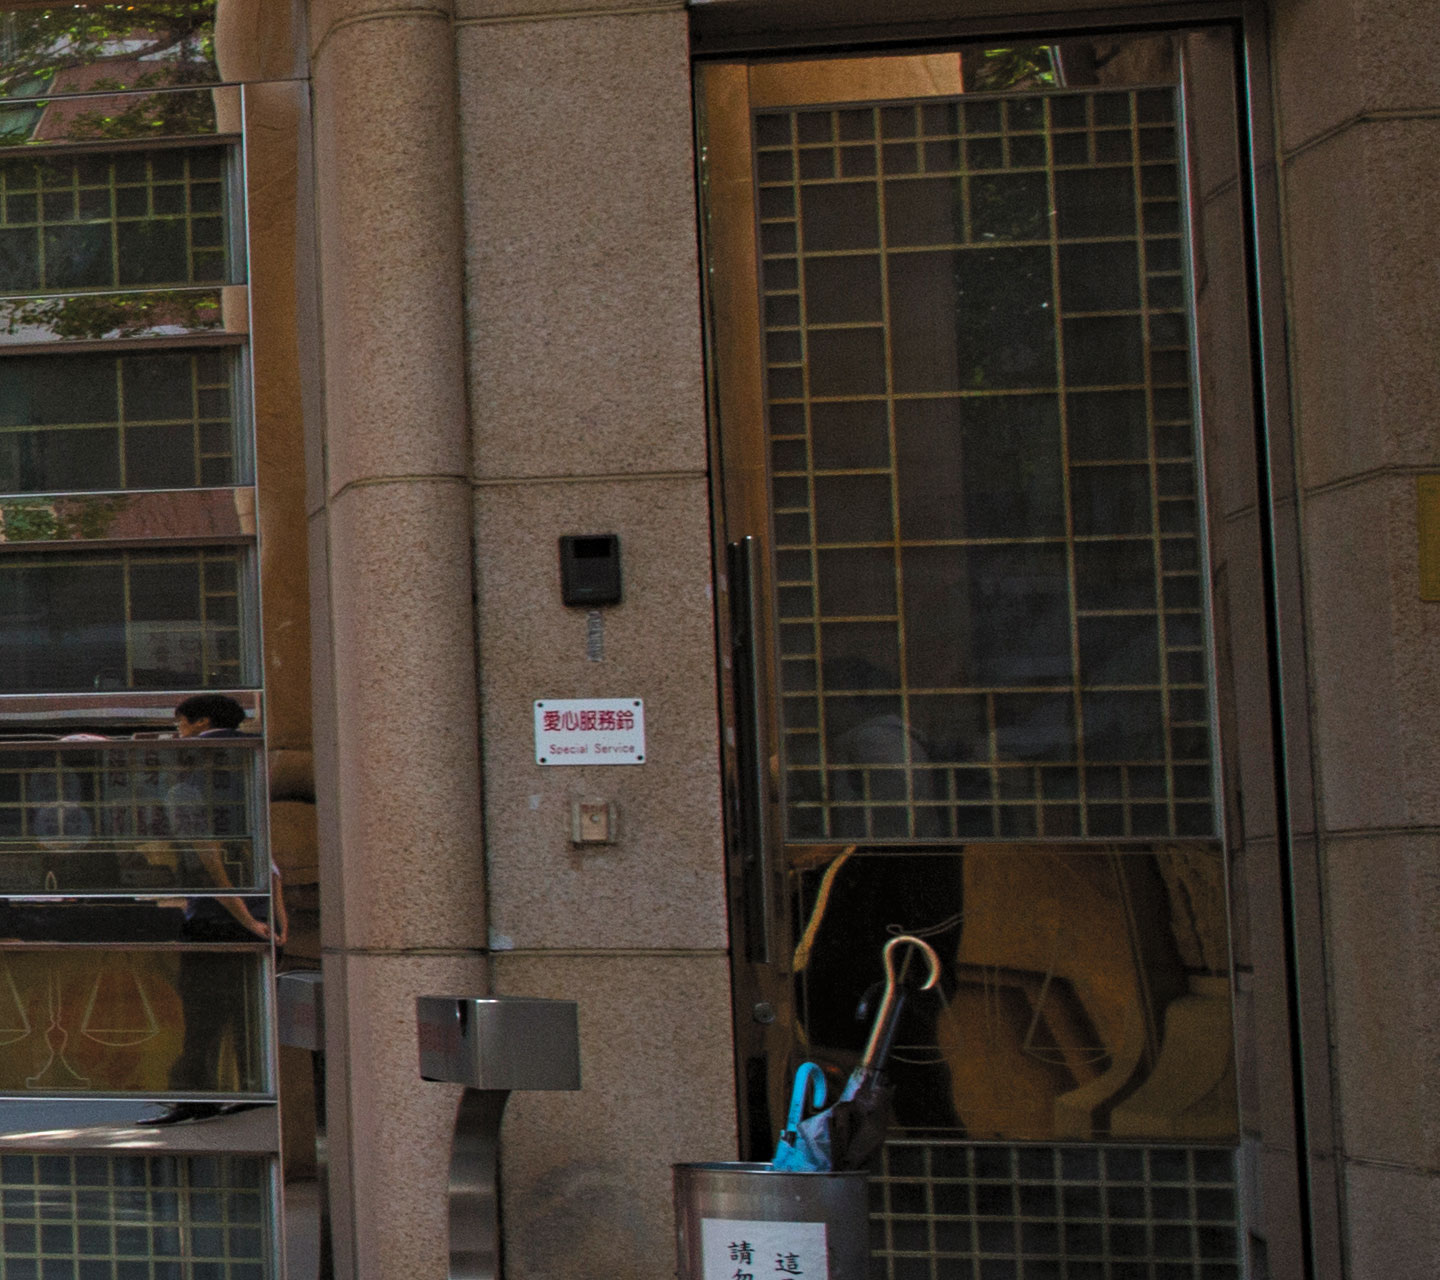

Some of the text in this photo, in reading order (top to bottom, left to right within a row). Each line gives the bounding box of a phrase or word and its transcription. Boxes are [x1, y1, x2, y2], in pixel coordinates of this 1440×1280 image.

[544, 710, 634, 732] 愛心服務鈴
[549, 743, 635, 755] Special Service
